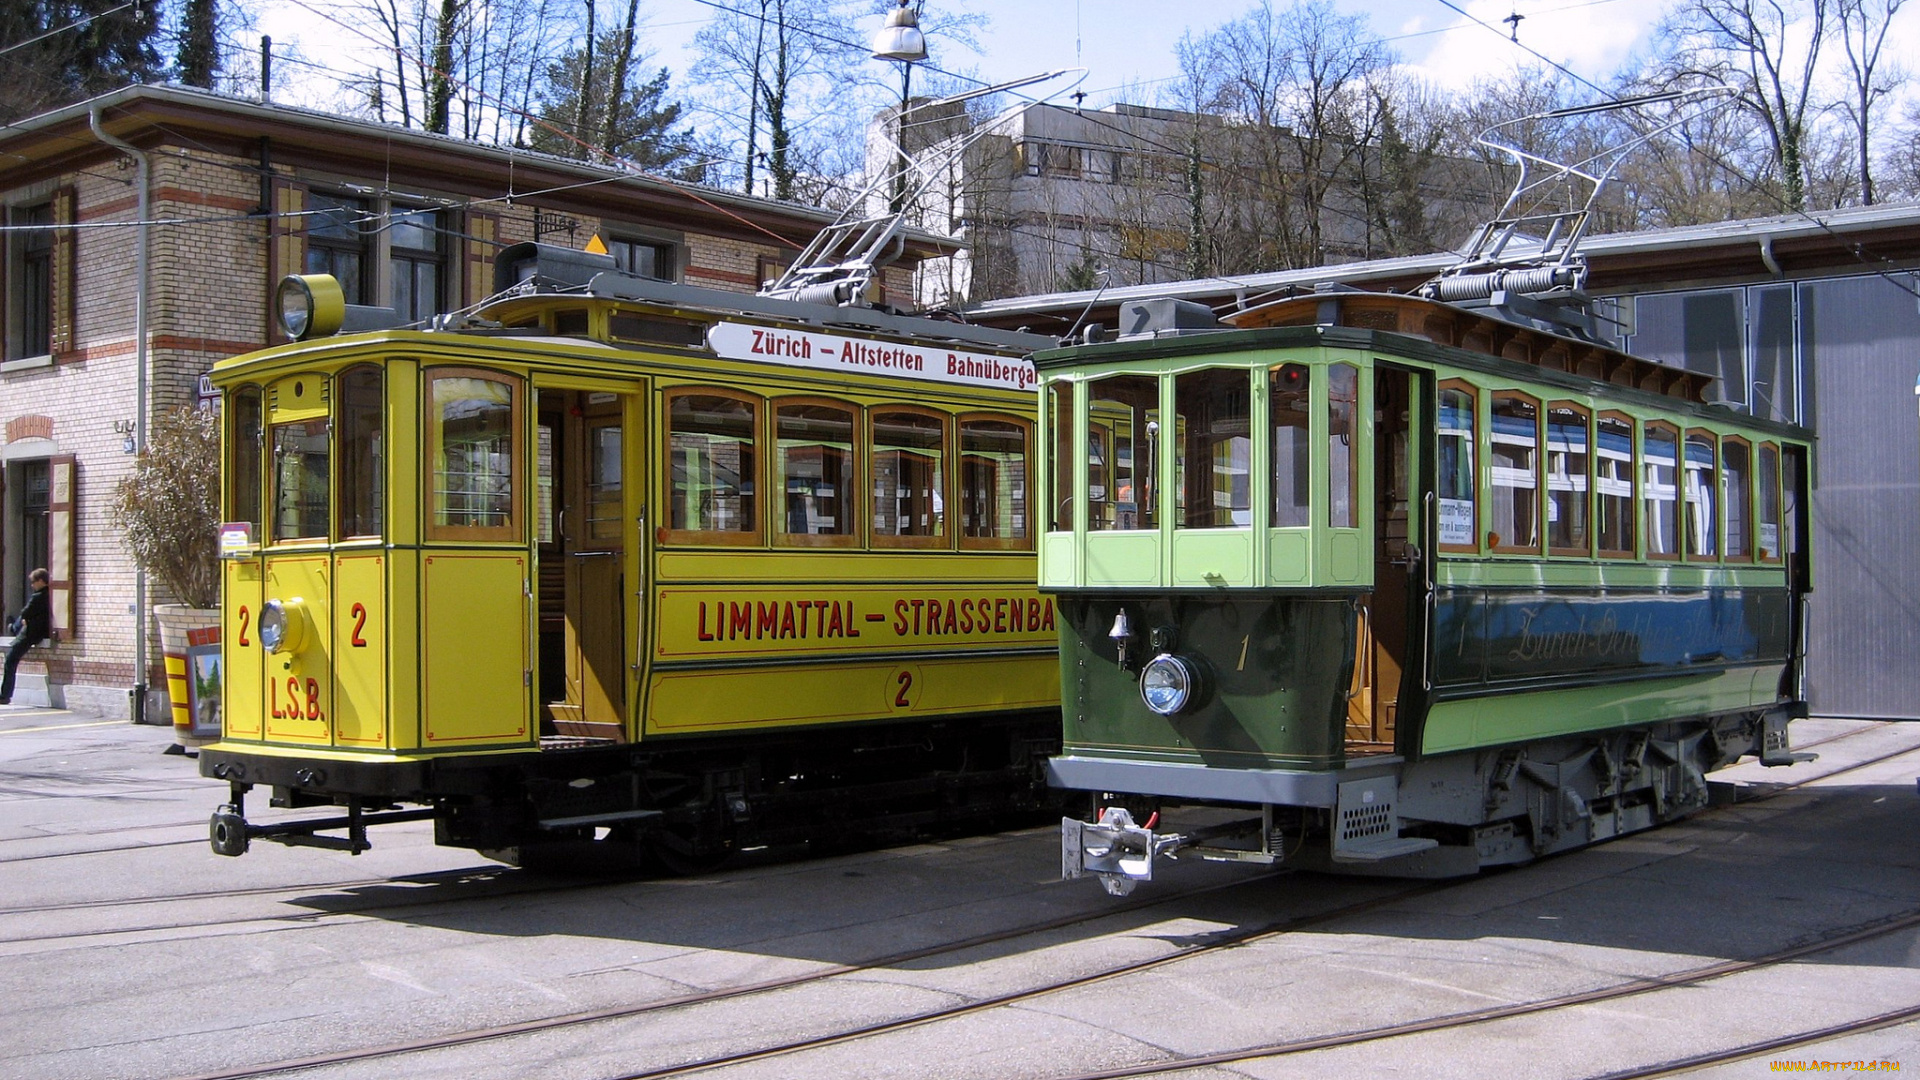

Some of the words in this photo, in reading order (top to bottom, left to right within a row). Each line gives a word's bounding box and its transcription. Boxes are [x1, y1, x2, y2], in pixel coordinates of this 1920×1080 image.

[751, 329, 811, 359] Zürich
[840, 341, 923, 372] Altstetten
[239, 605, 250, 647] 2
[351, 602, 367, 647] 2
[1236, 634, 1249, 671] 1
[271, 676, 325, 721] L.S.B.
[895, 671, 912, 707] 2
